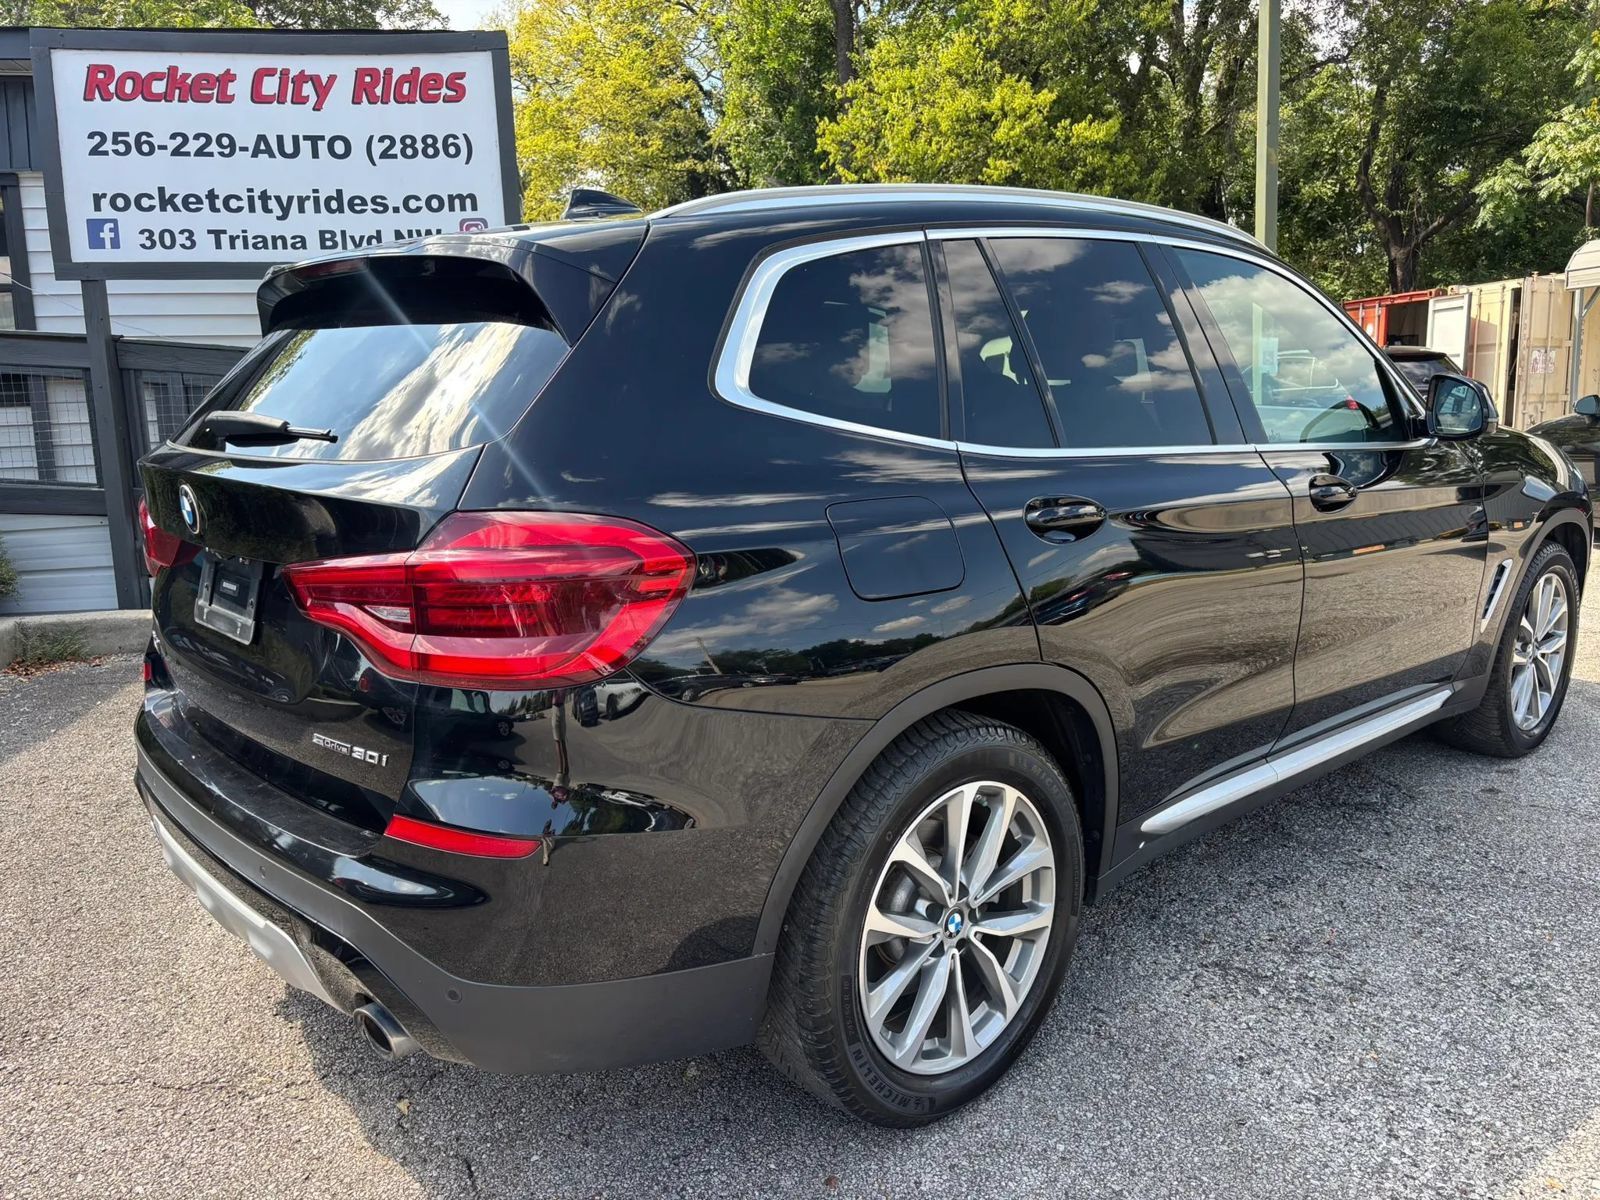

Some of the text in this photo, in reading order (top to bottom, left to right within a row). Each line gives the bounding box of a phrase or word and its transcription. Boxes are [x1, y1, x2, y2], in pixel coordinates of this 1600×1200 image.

[83, 64, 467, 111] Rocket City Rides
[86, 130, 474, 167] 256-229-AUTO (2886)
[92, 186, 479, 221] rocketcityrides.com
[138, 228, 197, 250] 303
[206, 228, 308, 251] Triana
[318, 229, 384, 250] Blvd
[851, 1047, 912, 1108] MICHELIN
